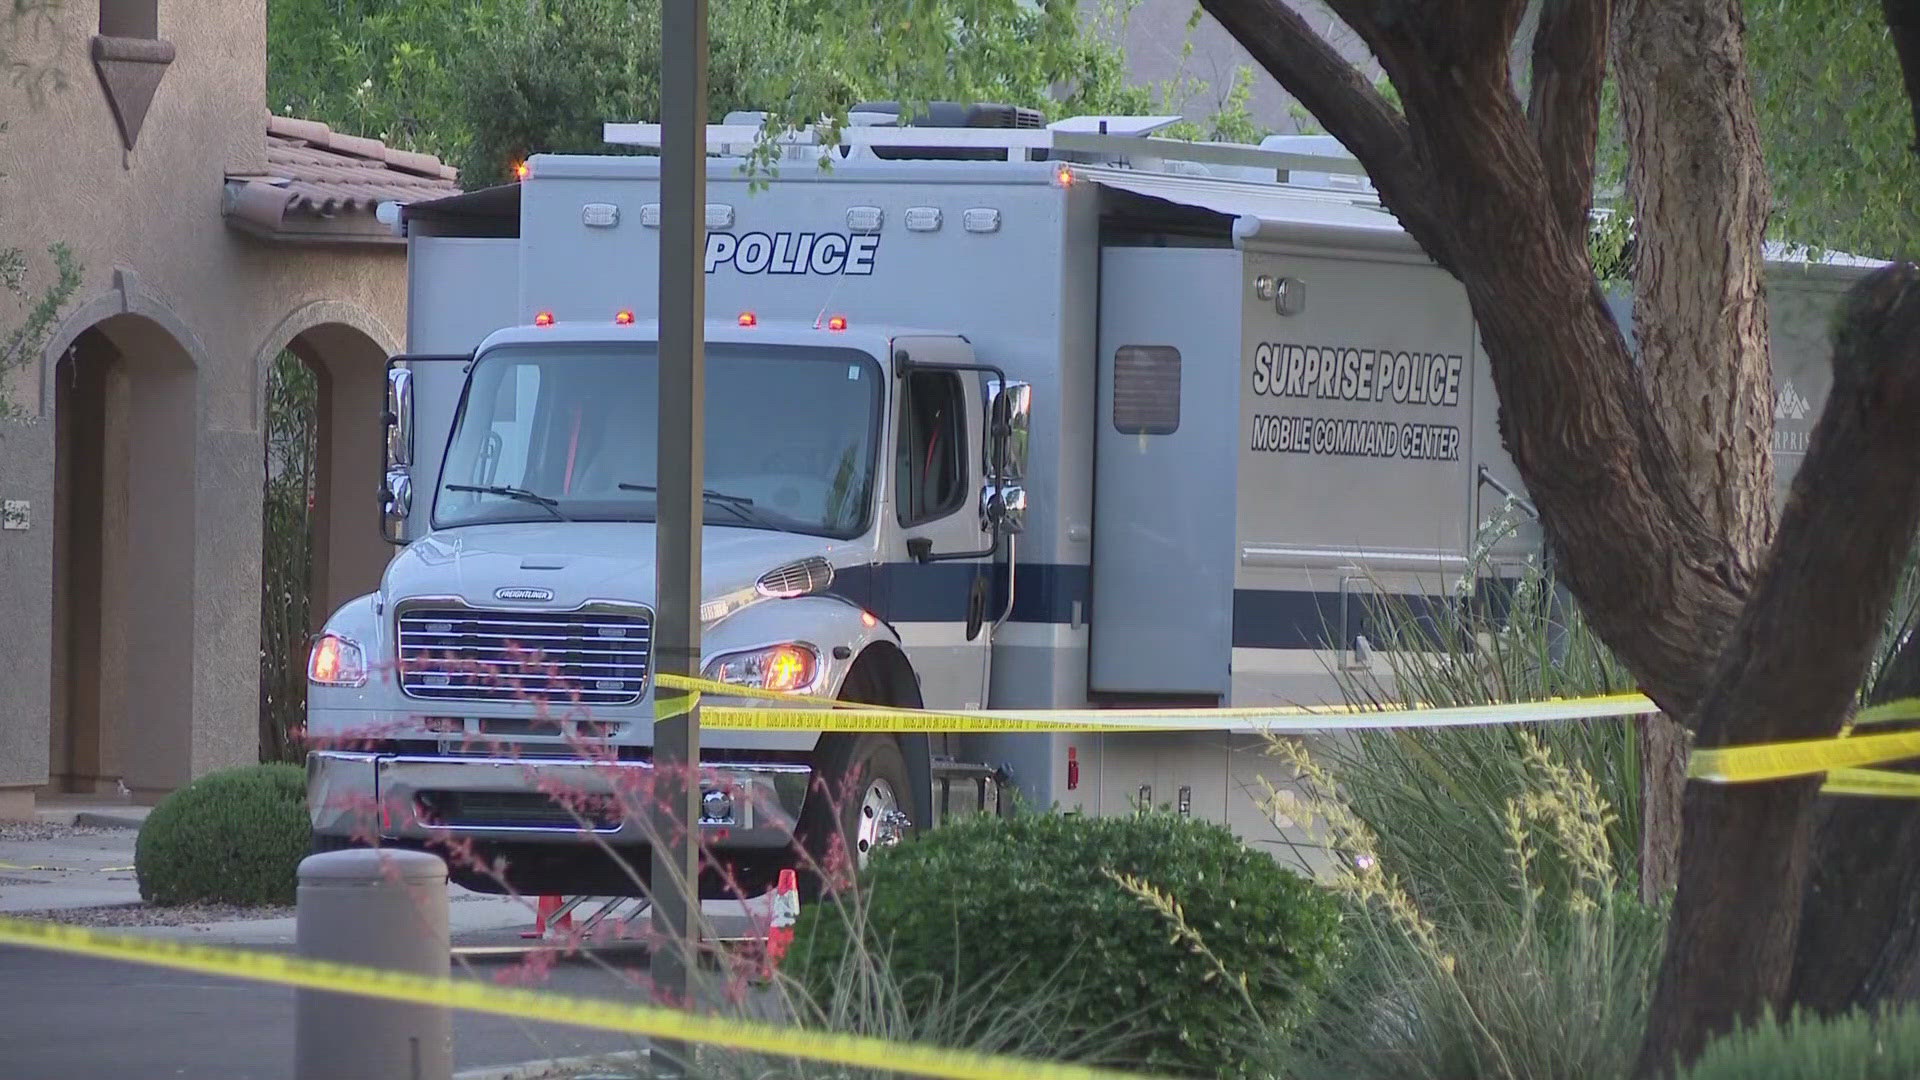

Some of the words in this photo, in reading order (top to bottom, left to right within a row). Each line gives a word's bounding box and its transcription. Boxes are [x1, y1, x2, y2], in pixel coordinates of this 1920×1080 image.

[705, 231, 881, 275] POLICE
[1253, 342, 1375, 400] SURPRISE
[1376, 351, 1462, 407] POLICE
[1251, 413, 1313, 454] MOBILE
[1313, 418, 1398, 458] COMMAND
[1400, 423, 1460, 462] CENTER
